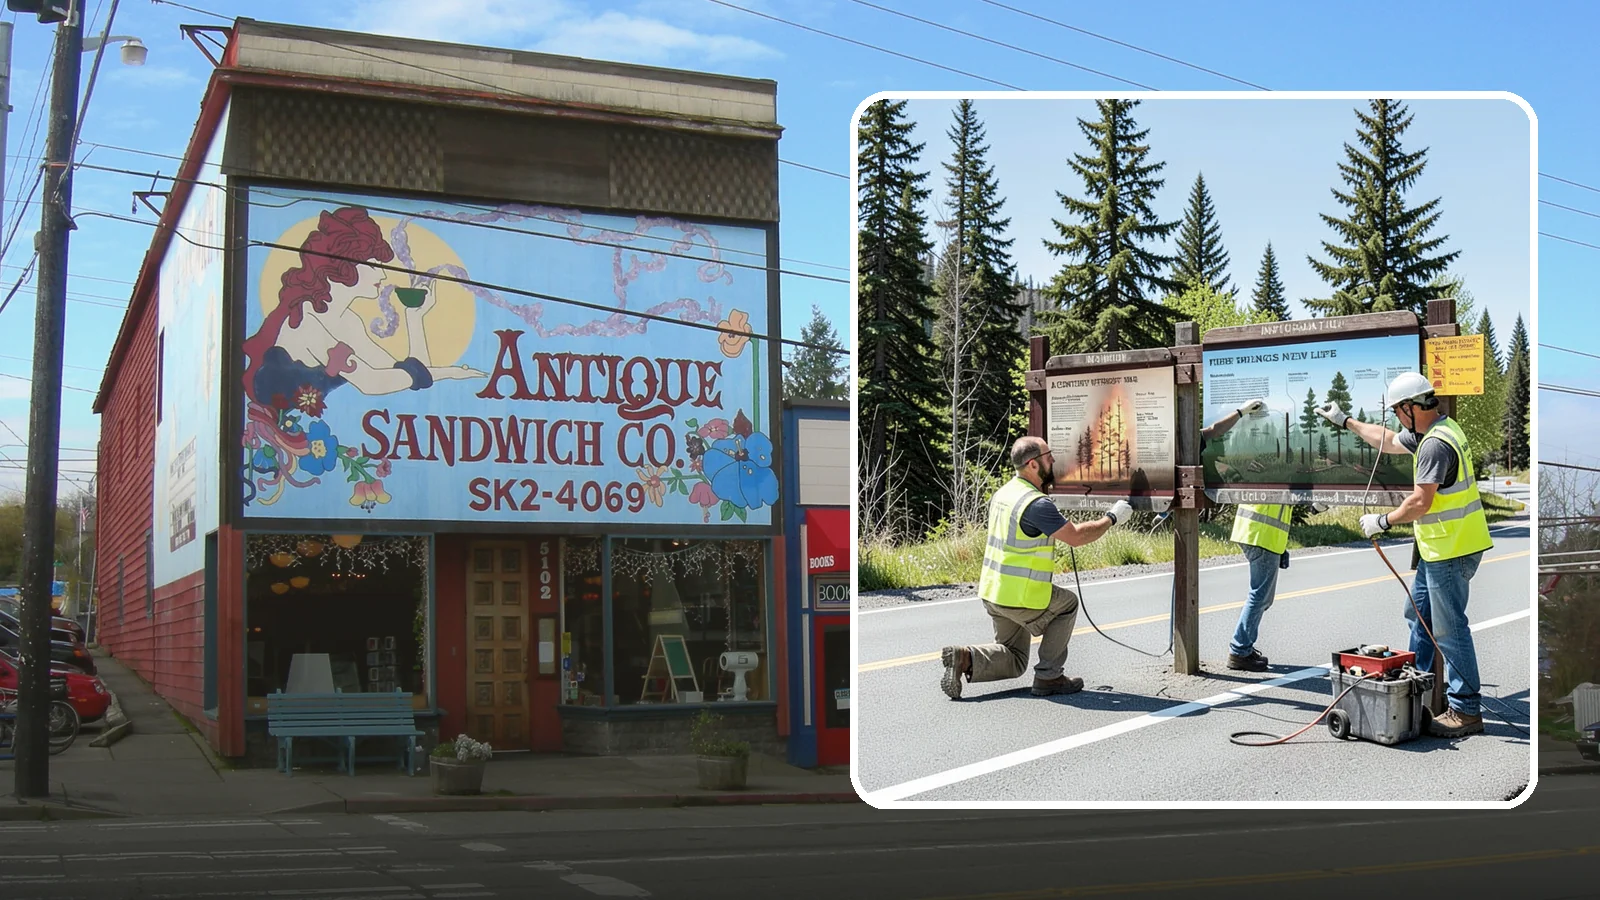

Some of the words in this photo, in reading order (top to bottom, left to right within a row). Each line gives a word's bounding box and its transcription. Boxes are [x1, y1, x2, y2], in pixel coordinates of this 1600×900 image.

[475, 329, 723, 421] ANTIQUE
[361, 408, 605, 467] SANDWICH
[616, 422, 685, 469] CO.
[468, 477, 645, 513] SK2-4069
[540, 541, 551, 600] 5102
[809, 555, 835, 569] BOOKS
